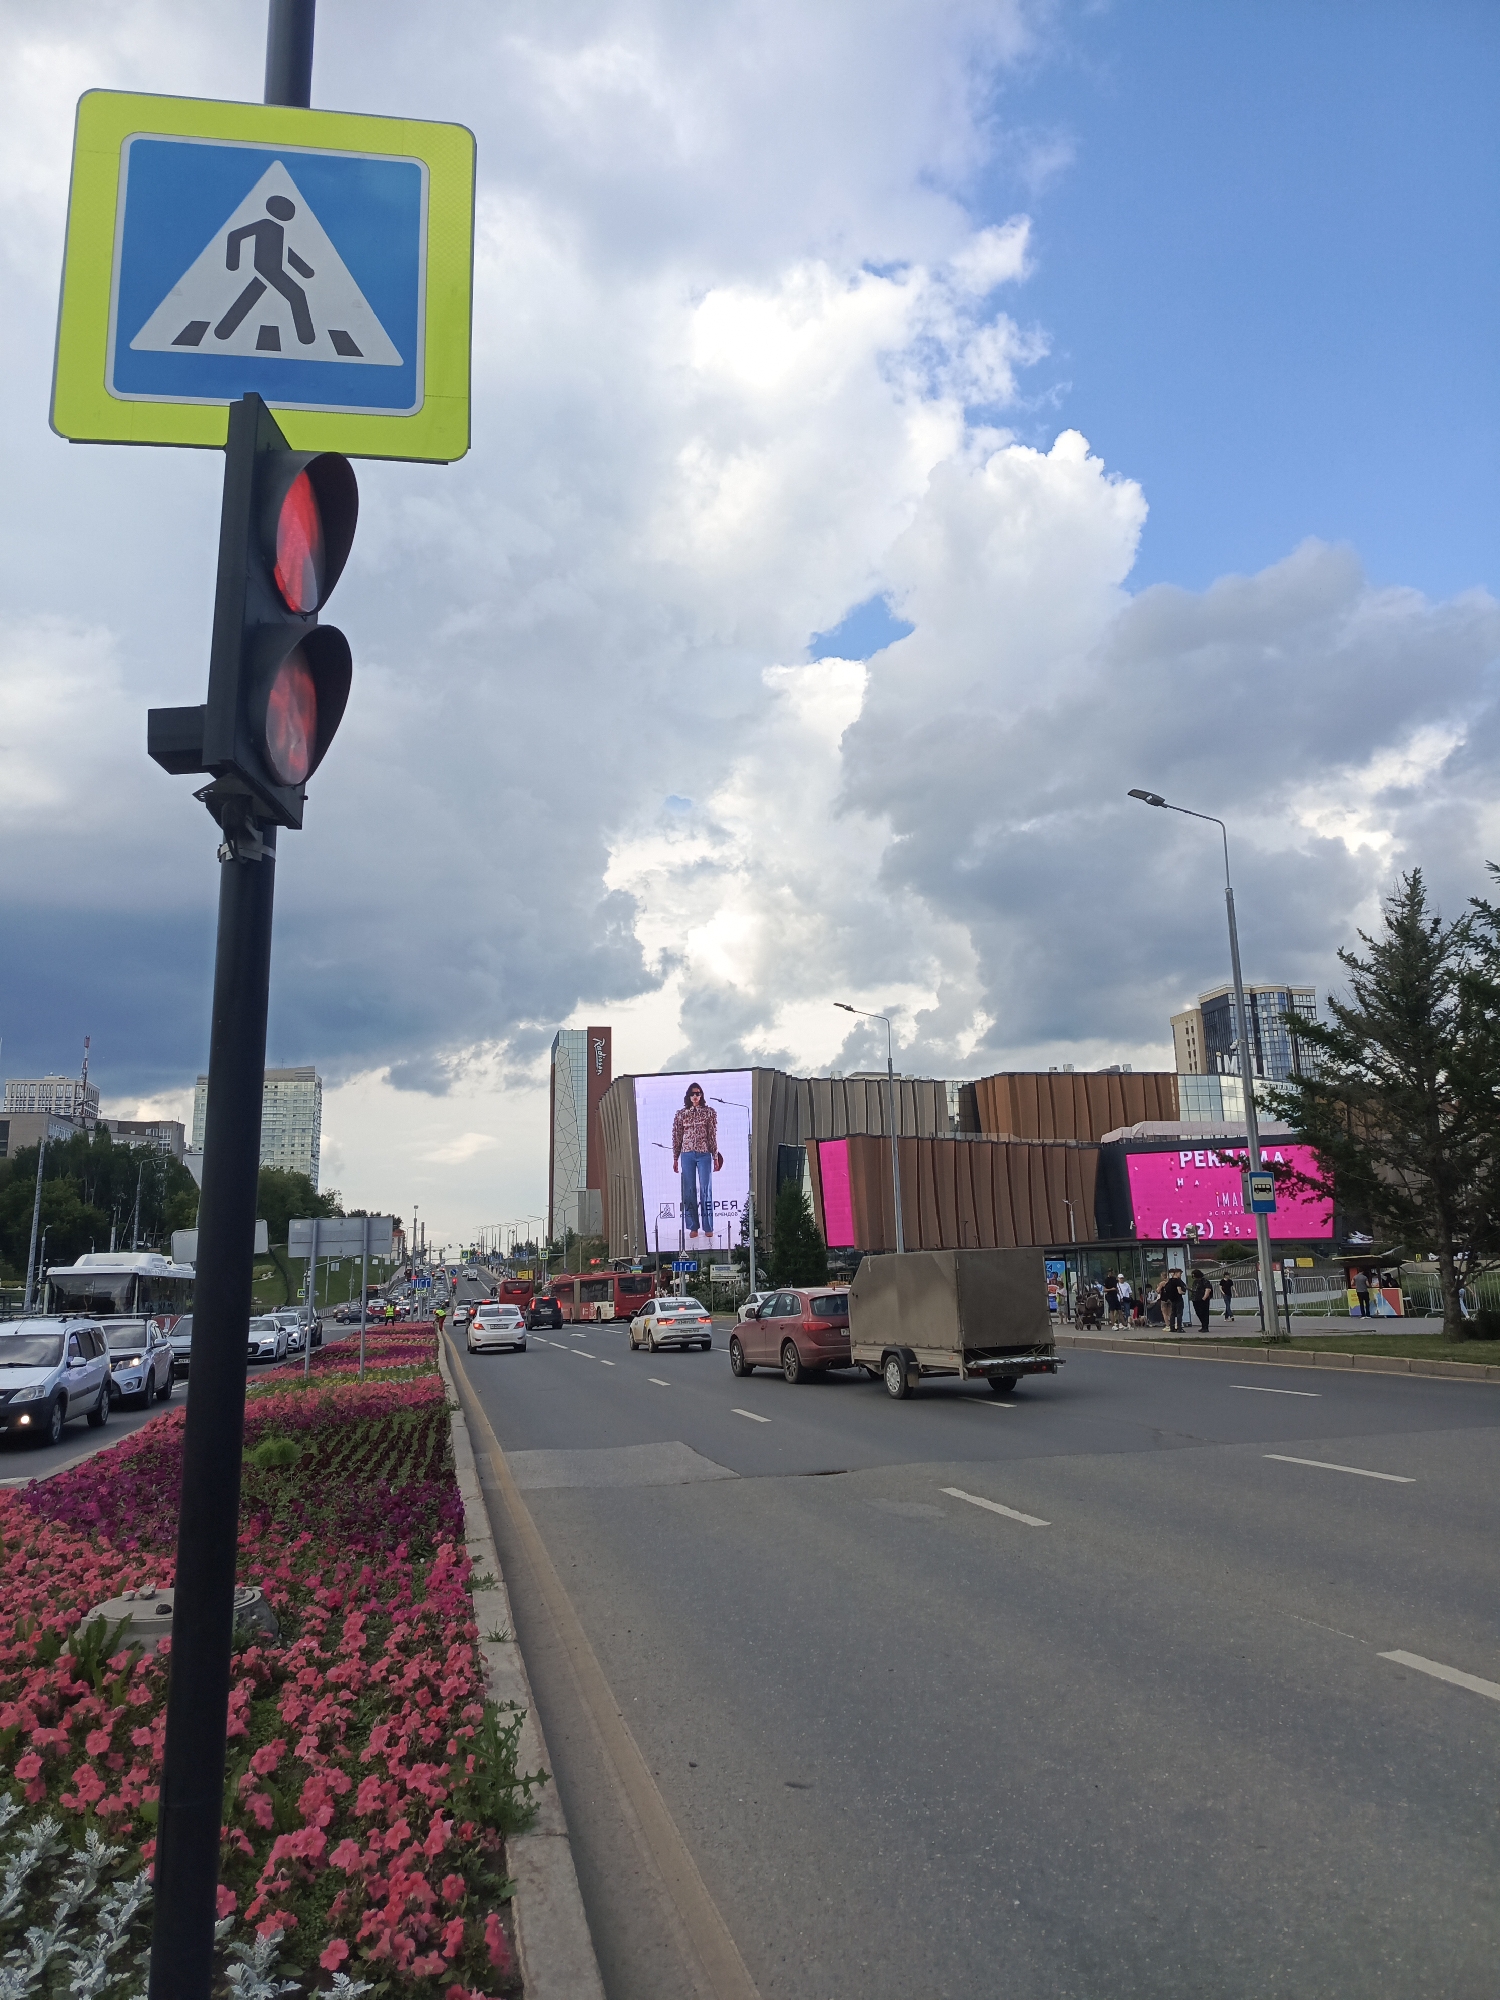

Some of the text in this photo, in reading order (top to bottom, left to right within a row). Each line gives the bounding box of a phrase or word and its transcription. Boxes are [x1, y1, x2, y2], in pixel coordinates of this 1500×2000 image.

[592, 1037, 607, 1076] Radisson
[1216, 1051, 1273, 1078] iMLL
[1216, 1191, 1244, 1208] iMAL
